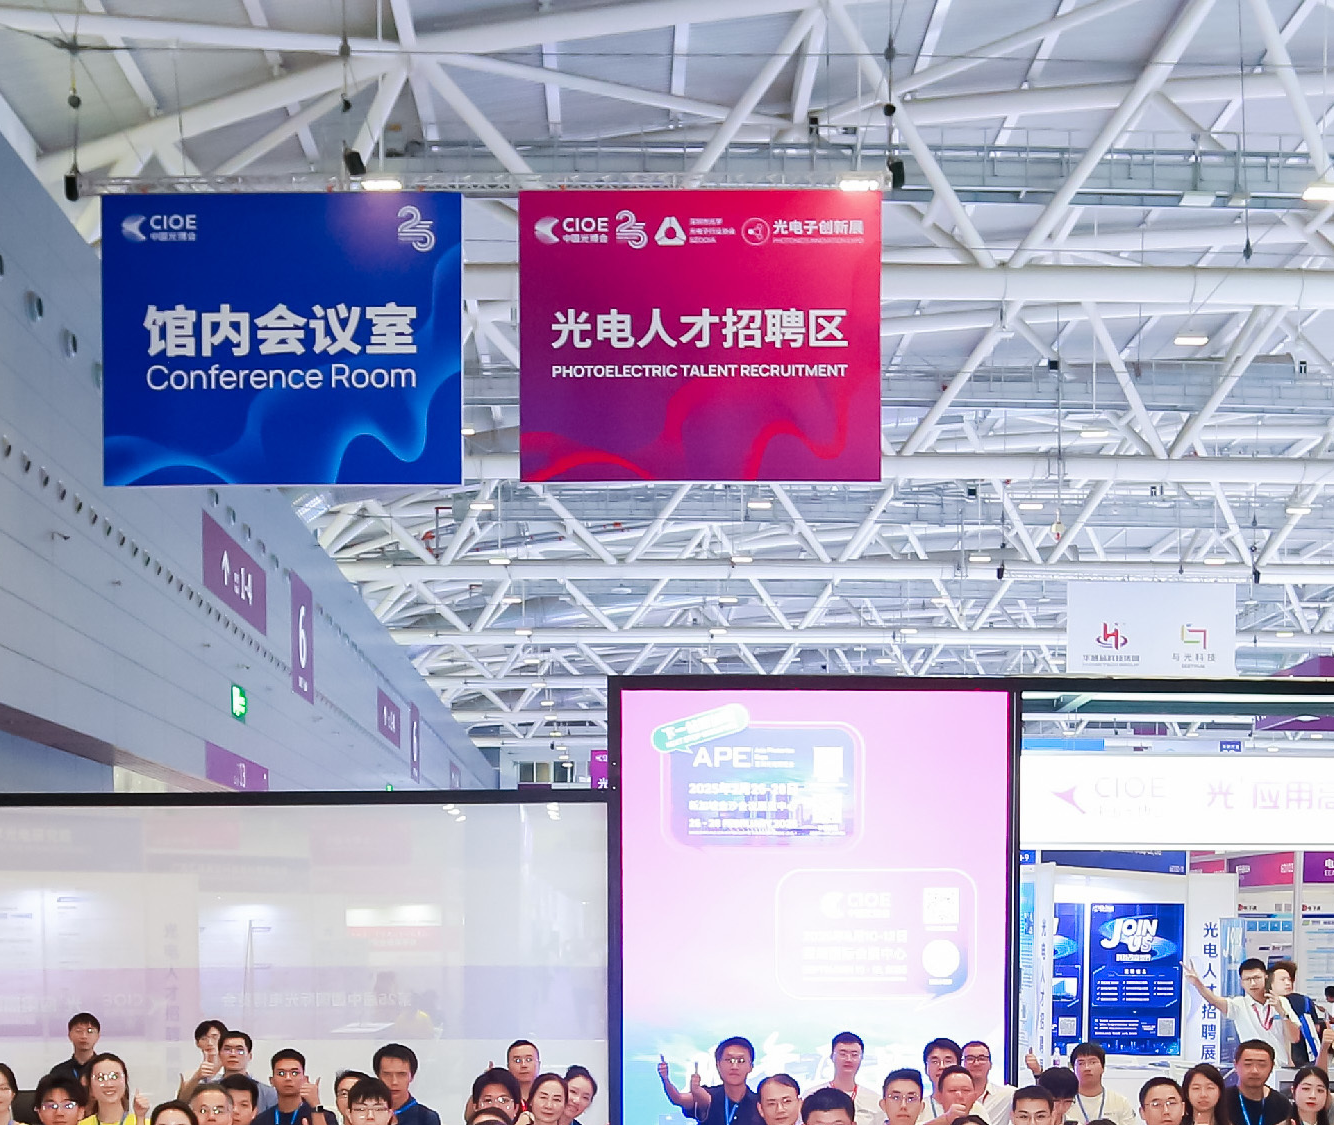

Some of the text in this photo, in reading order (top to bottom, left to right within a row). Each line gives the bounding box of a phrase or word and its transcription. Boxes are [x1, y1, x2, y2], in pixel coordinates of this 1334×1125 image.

[150, 214, 197, 231] CIOE
[562, 217, 609, 232] CIOE
[772, 219, 864, 236] 光电子创新展
[143, 302, 417, 357] 馆内会议室
[552, 308, 848, 349] 光电人才招聘区
[146, 364, 417, 390] Conference Room
[552, 364, 848, 378] PHOTOELECTRIC TALENT RECRUITMENT
[298, 605, 308, 669] 6
[692, 747, 751, 768] APE
[1100, 919, 1159, 950] JOIN
[1126, 936, 1154, 952] US
